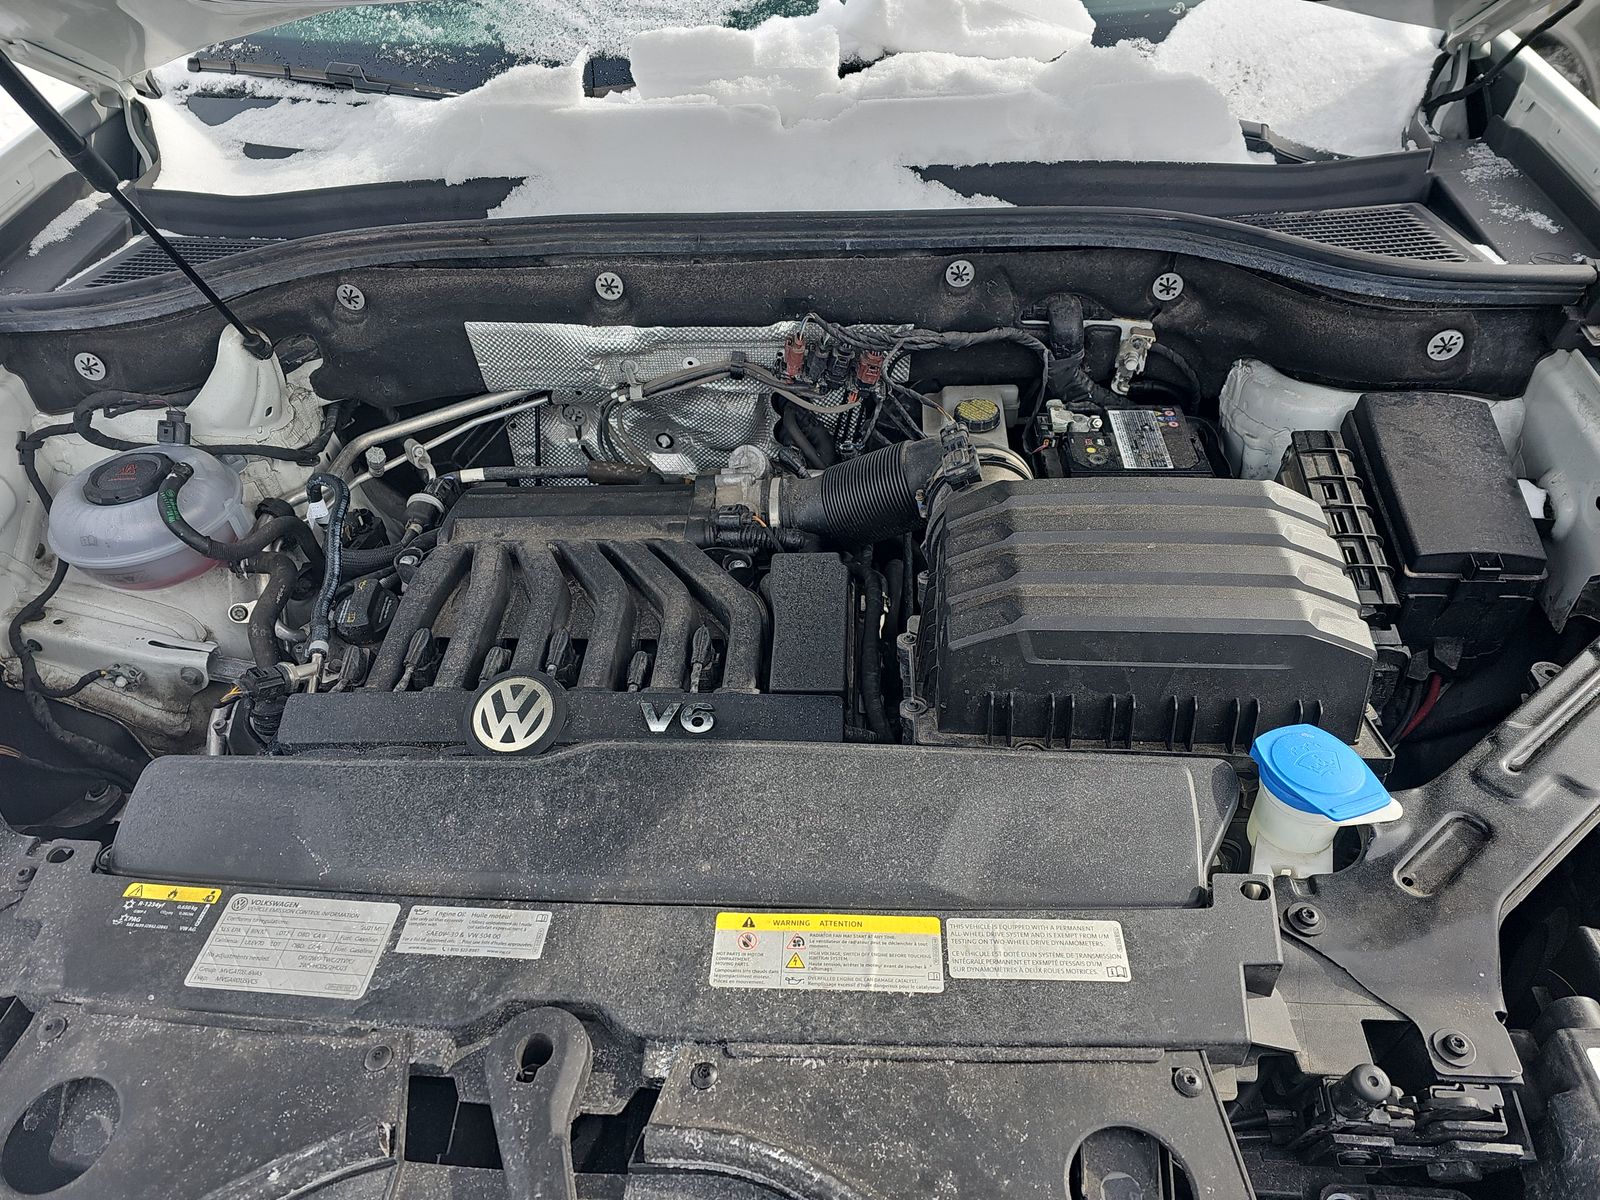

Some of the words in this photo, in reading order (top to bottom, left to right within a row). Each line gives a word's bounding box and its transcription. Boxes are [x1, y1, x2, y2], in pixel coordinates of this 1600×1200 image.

[640, 702, 716, 733] V6
[138, 900, 165, 908] R-1234yf
[250, 900, 300, 908] VOLKSWAGEN
[952, 956, 984, 965] INTÉGRALE
